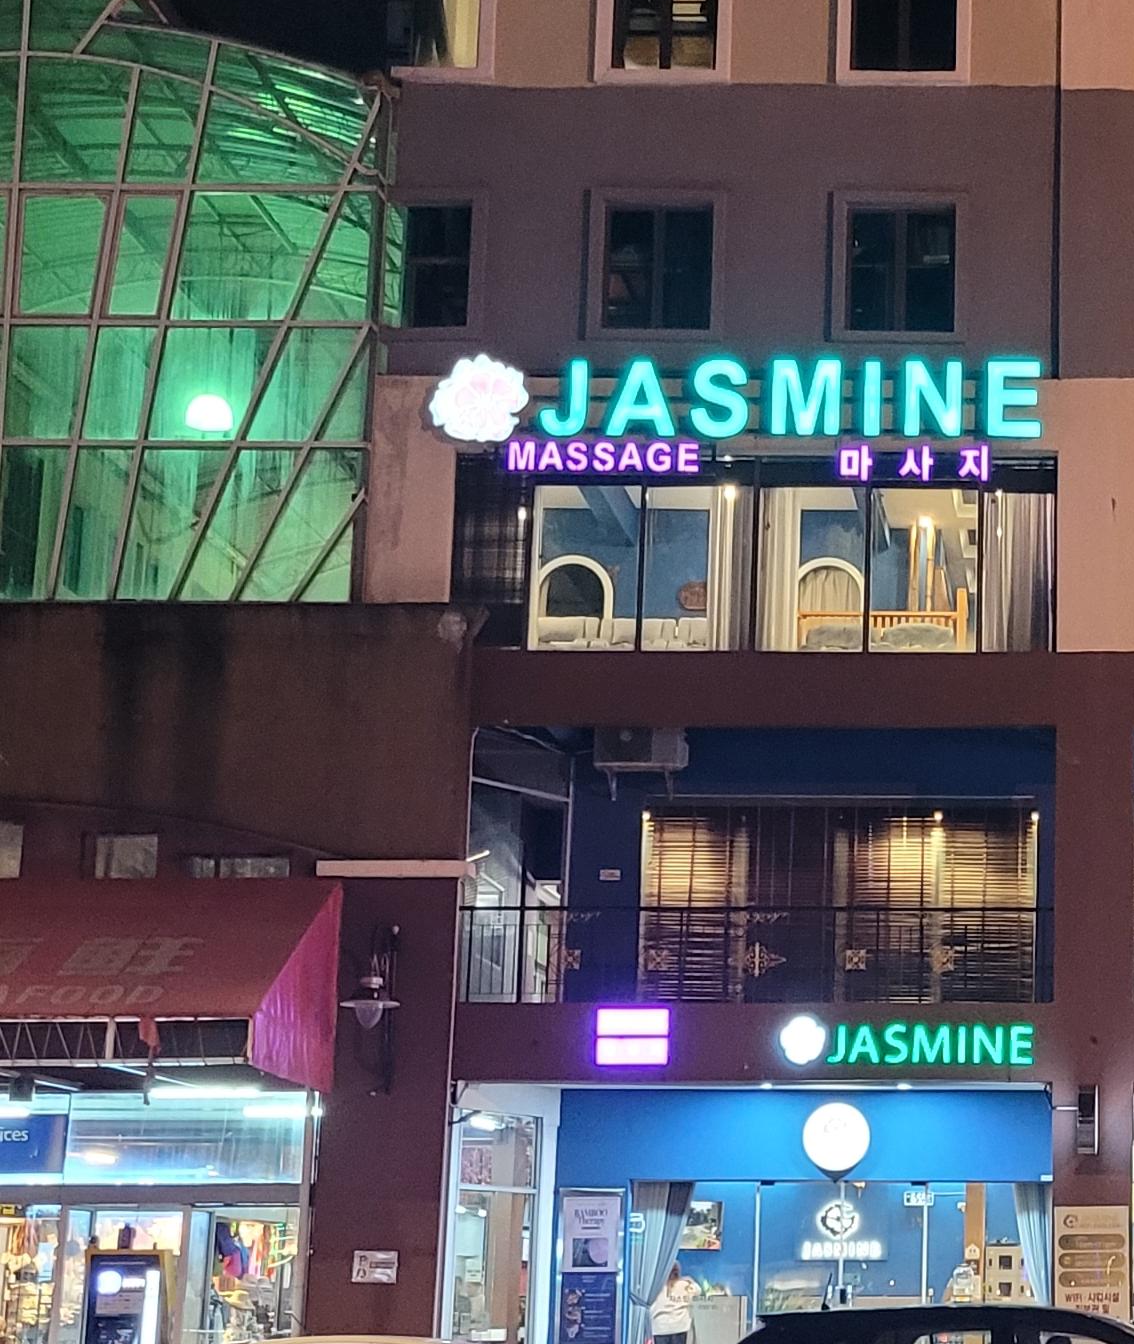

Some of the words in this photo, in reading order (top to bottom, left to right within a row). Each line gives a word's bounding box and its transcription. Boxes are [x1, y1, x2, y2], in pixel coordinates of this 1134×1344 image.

[538, 358, 1043, 439] JASMINE
[507, 441, 701, 474] MASSAGE
[826, 1024, 1035, 1066] JASMINE
